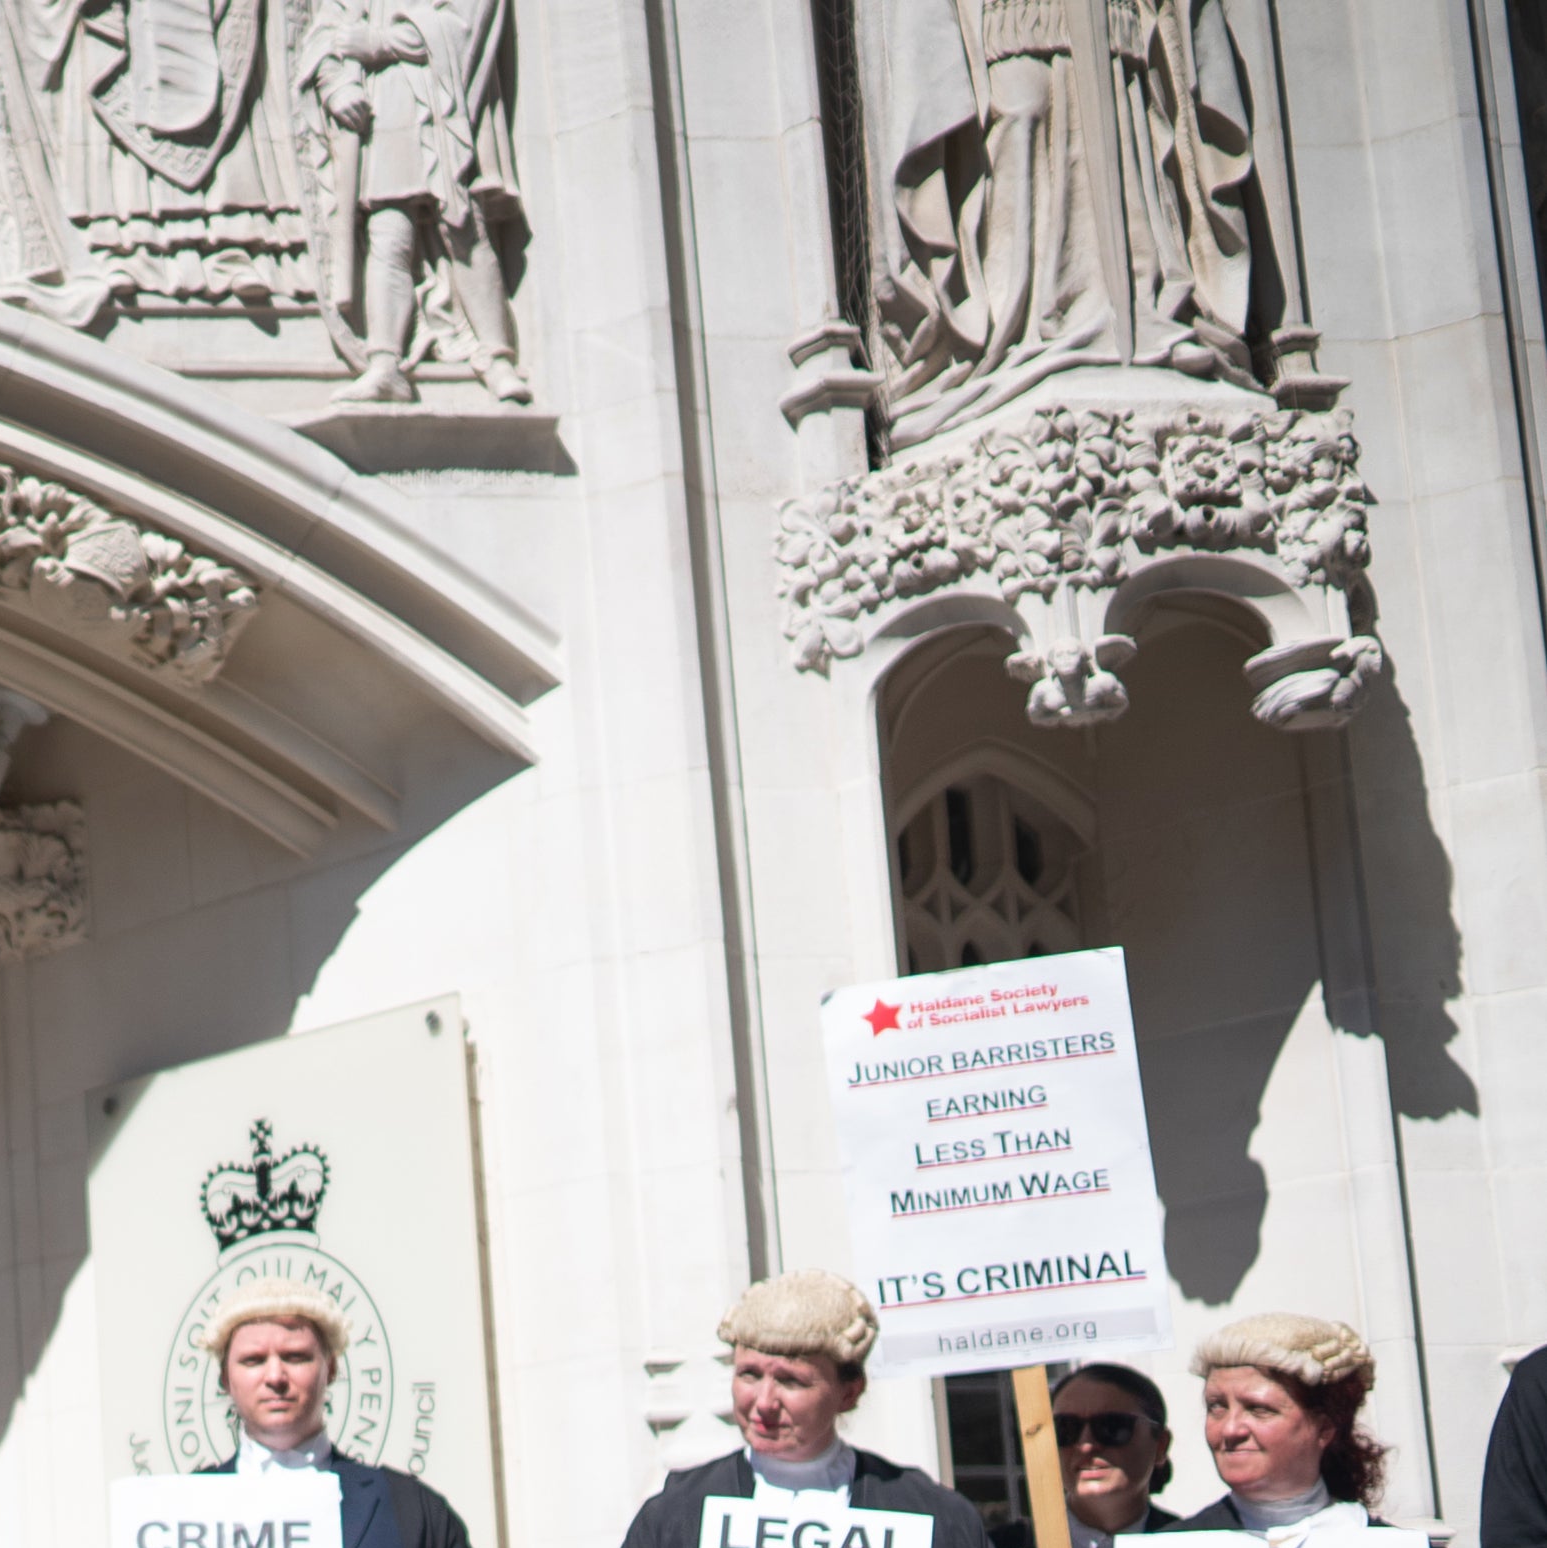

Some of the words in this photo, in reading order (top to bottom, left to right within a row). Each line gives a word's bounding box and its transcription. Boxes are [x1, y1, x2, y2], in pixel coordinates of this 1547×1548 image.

[906, 1013, 925, 1030] of
[928, 1003, 1009, 1027] Socialist
[1012, 992, 1091, 1019] Lawyers
[909, 990, 986, 1015] Haldane
[989, 982, 1059, 1002] Society
[847, 1054, 945, 1085] JUNIOR
[951, 1031, 1116, 1073] BARRISTERS
[925, 1085, 1048, 1120] EARNING
[915, 1137, 987, 1166] LESS
[993, 1127, 1072, 1155] THAN
[889, 1180, 1013, 1214] MINIMUM
[1019, 1168, 1111, 1197] WAGE
[877, 1271, 946, 1305] IT'S
[956, 1248, 1147, 1293] CRIMINAL
[355, 1324, 378, 1348] Y
[937, 1317, 1099, 1354] haldane.org
[407, 1381, 436, 1474] ouncil
